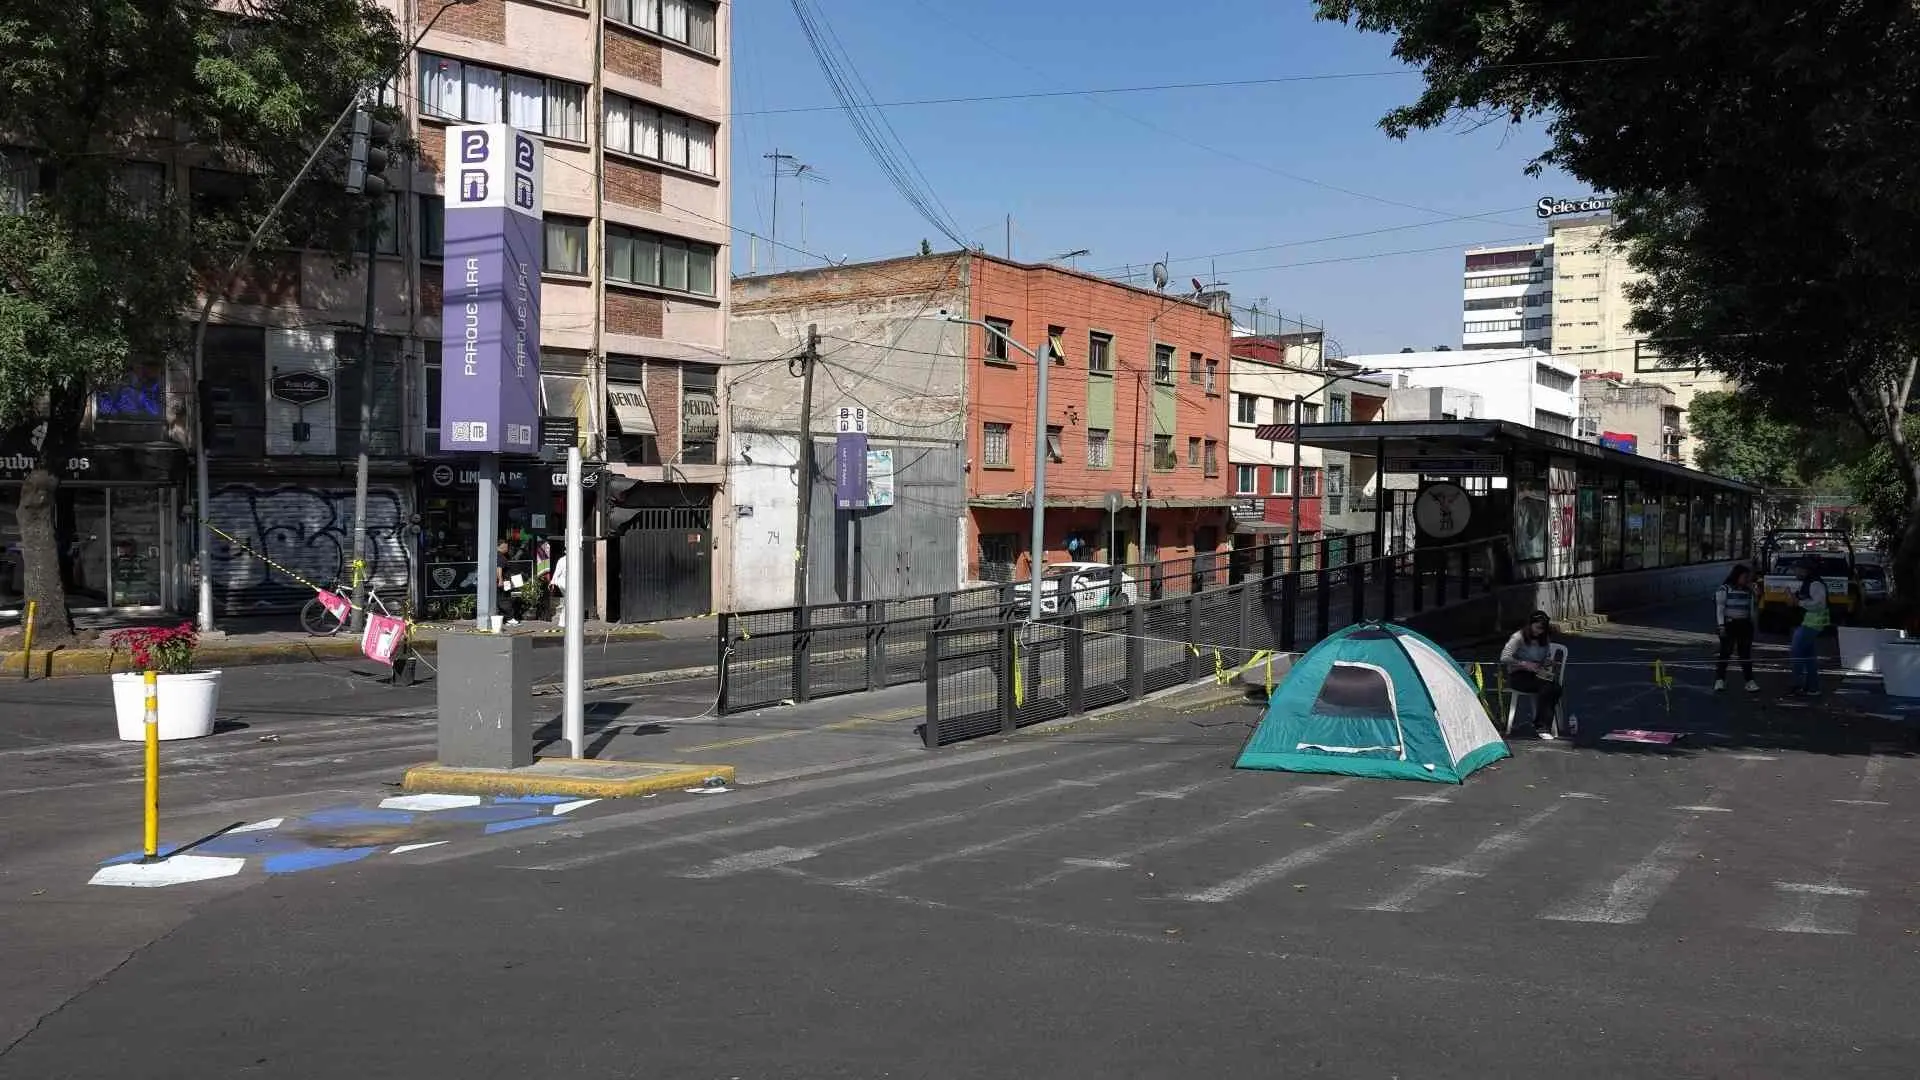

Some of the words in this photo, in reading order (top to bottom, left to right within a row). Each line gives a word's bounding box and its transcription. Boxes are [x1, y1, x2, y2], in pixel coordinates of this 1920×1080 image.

[1538, 197, 1612, 217] Seleccion
[466, 257, 479, 297] LIRA
[464, 303, 479, 377] PARQUE
[517, 307, 528, 378] PARQUE
[611, 391, 647, 409] DENTAL
[683, 398, 719, 416] DENTAL
[767, 529, 780, 545] 74
